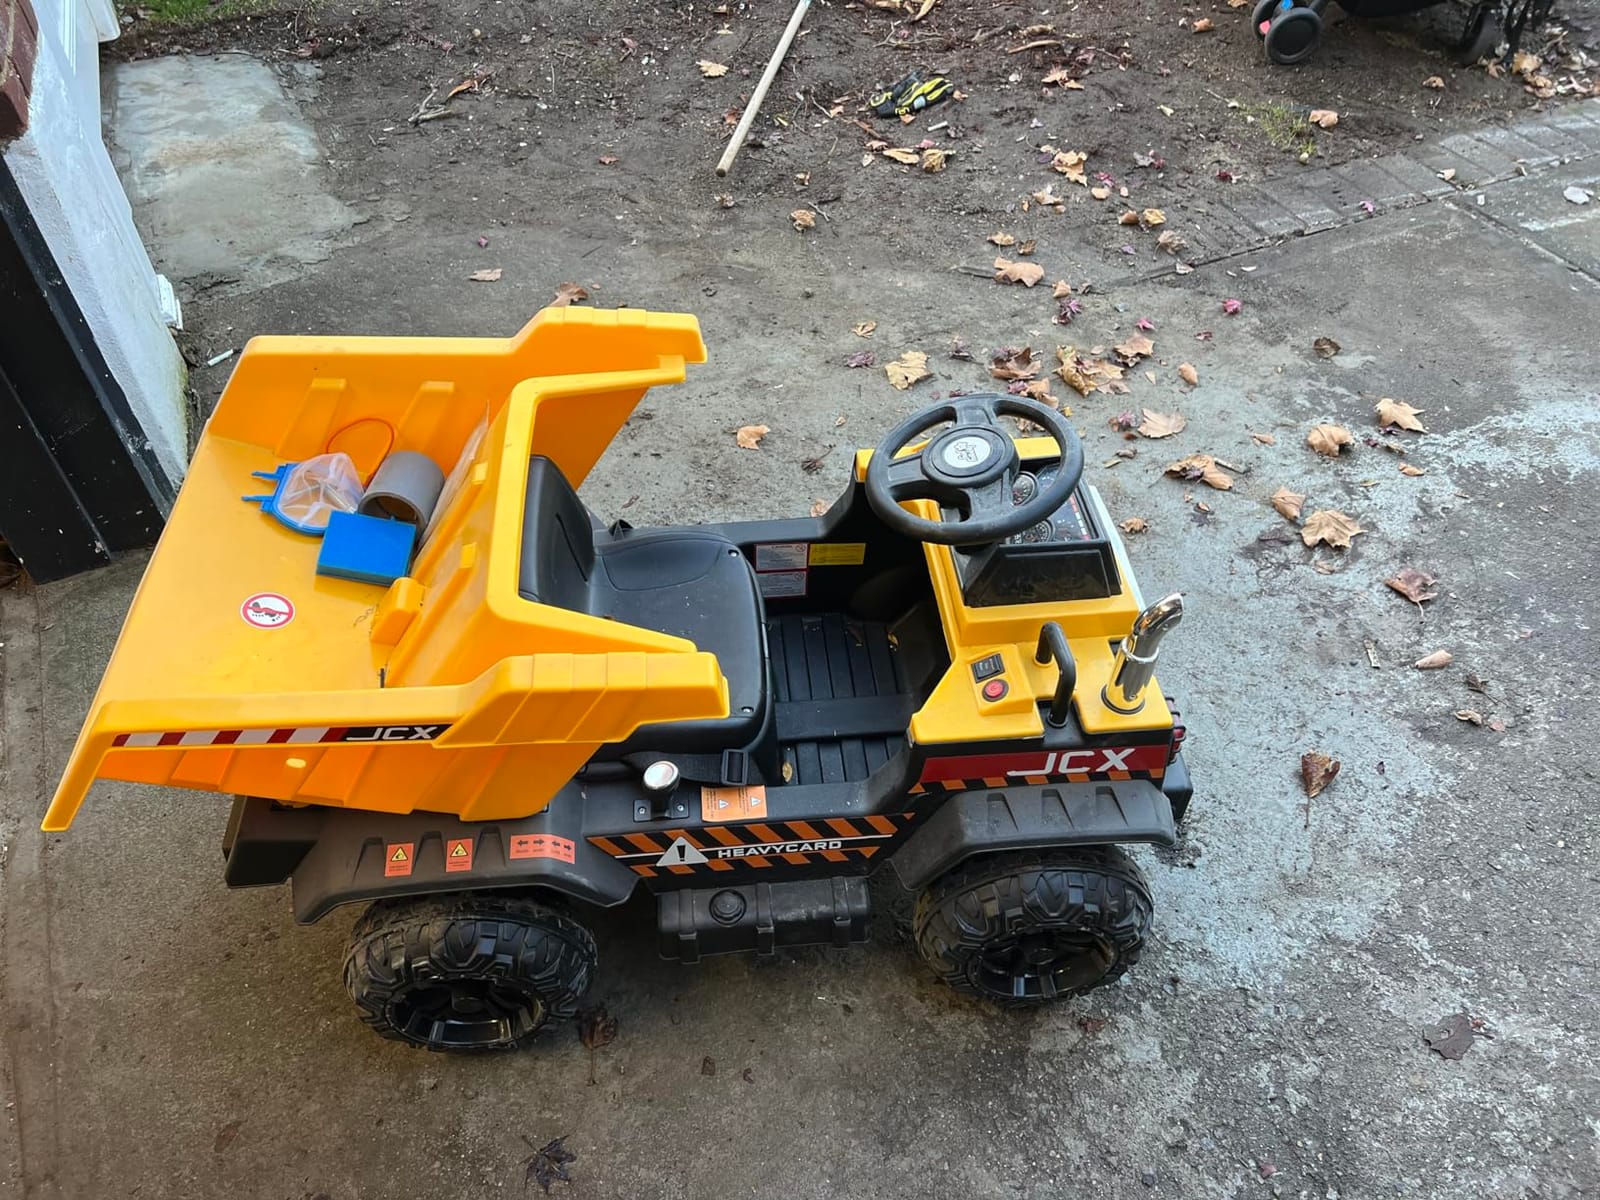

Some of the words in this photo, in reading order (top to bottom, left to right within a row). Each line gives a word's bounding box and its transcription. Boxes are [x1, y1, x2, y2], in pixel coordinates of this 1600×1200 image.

[345, 726, 438, 741] JCX
[1006, 748, 1136, 776] JCX
[717, 840, 843, 859] HEAVYCARD
